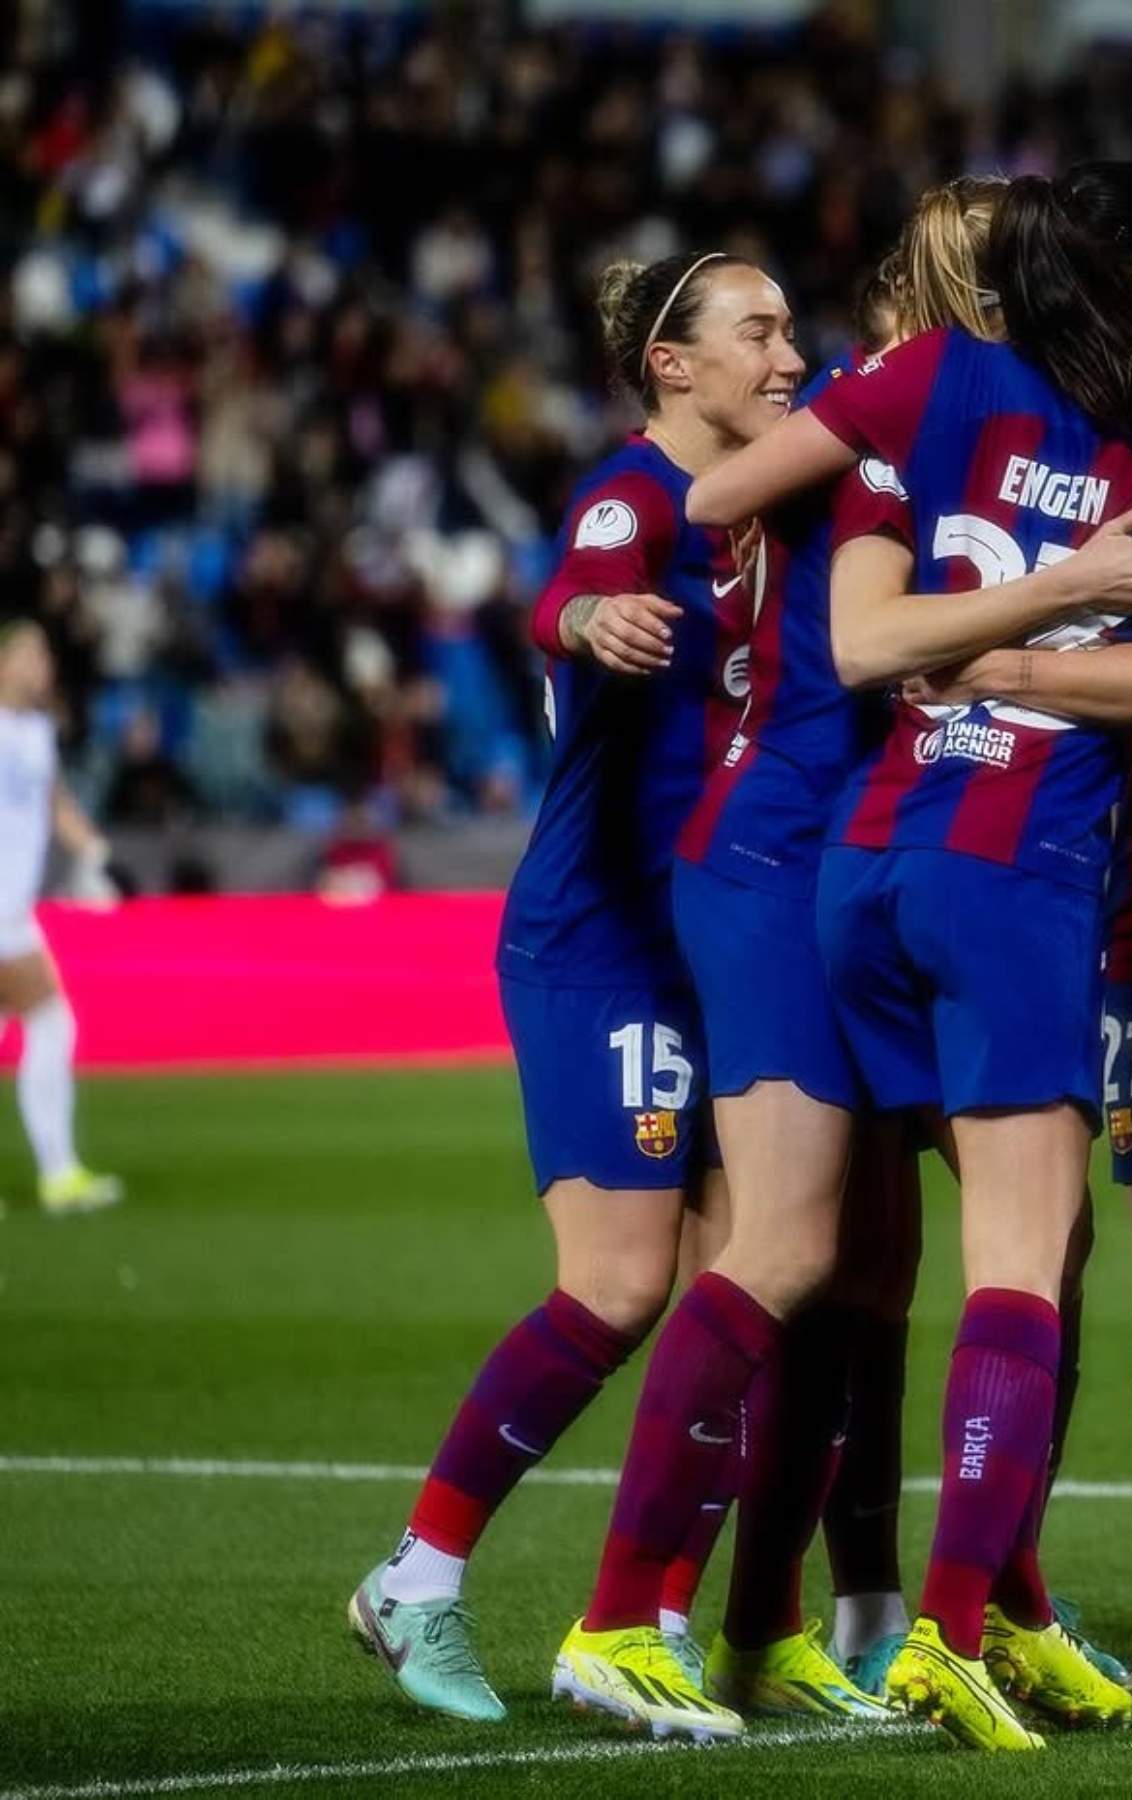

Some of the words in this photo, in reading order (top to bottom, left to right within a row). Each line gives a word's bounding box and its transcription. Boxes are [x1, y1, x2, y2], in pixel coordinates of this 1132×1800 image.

[998, 454, 1110, 525] ENGEN
[944, 736, 1013, 763] ACNUR
[945, 721, 1016, 748] UNHCR
[609, 1021, 693, 1110] 15
[959, 1415, 993, 1480] BARÇA
